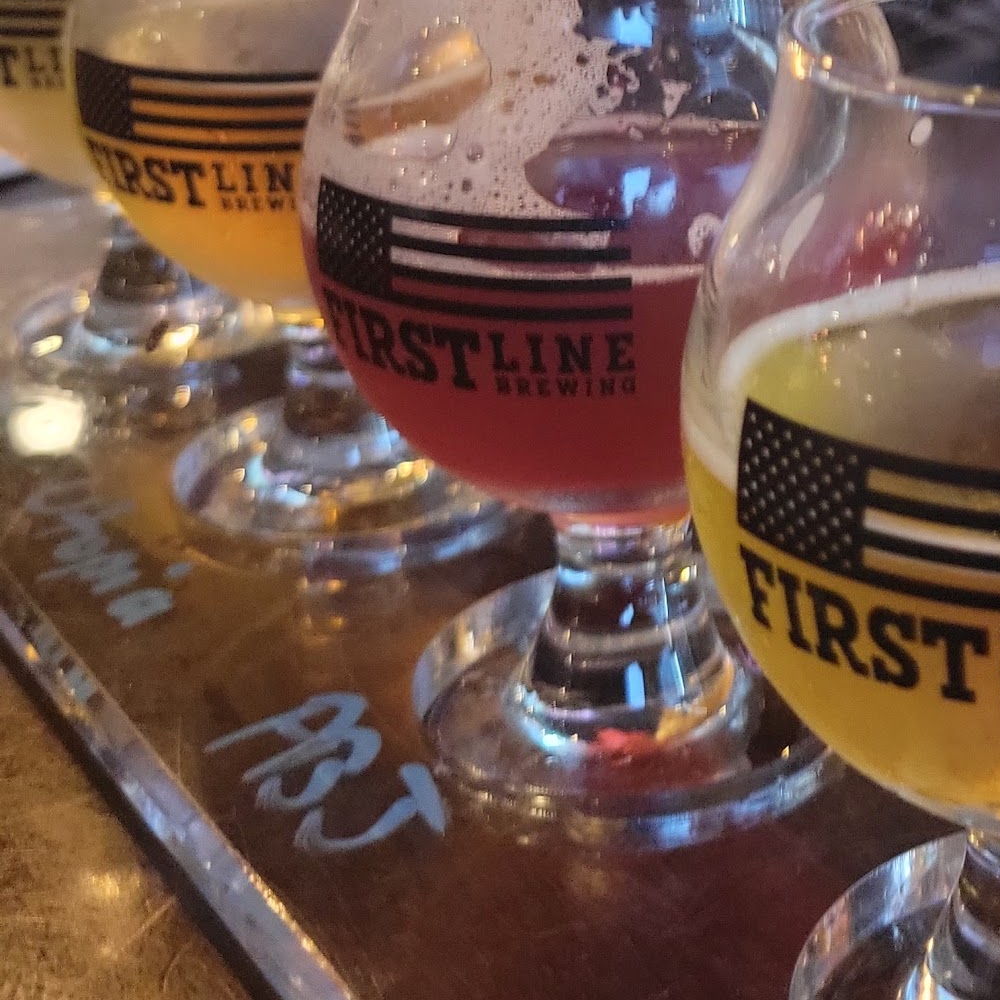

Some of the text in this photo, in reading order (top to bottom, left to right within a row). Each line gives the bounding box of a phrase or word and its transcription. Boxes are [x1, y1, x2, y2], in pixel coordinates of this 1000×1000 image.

[211, 161, 294, 193] LIN
[322, 286, 636, 391] FIRST LINE
[496, 374, 637, 396] BREWING
[738, 543, 990, 703] FIRST
